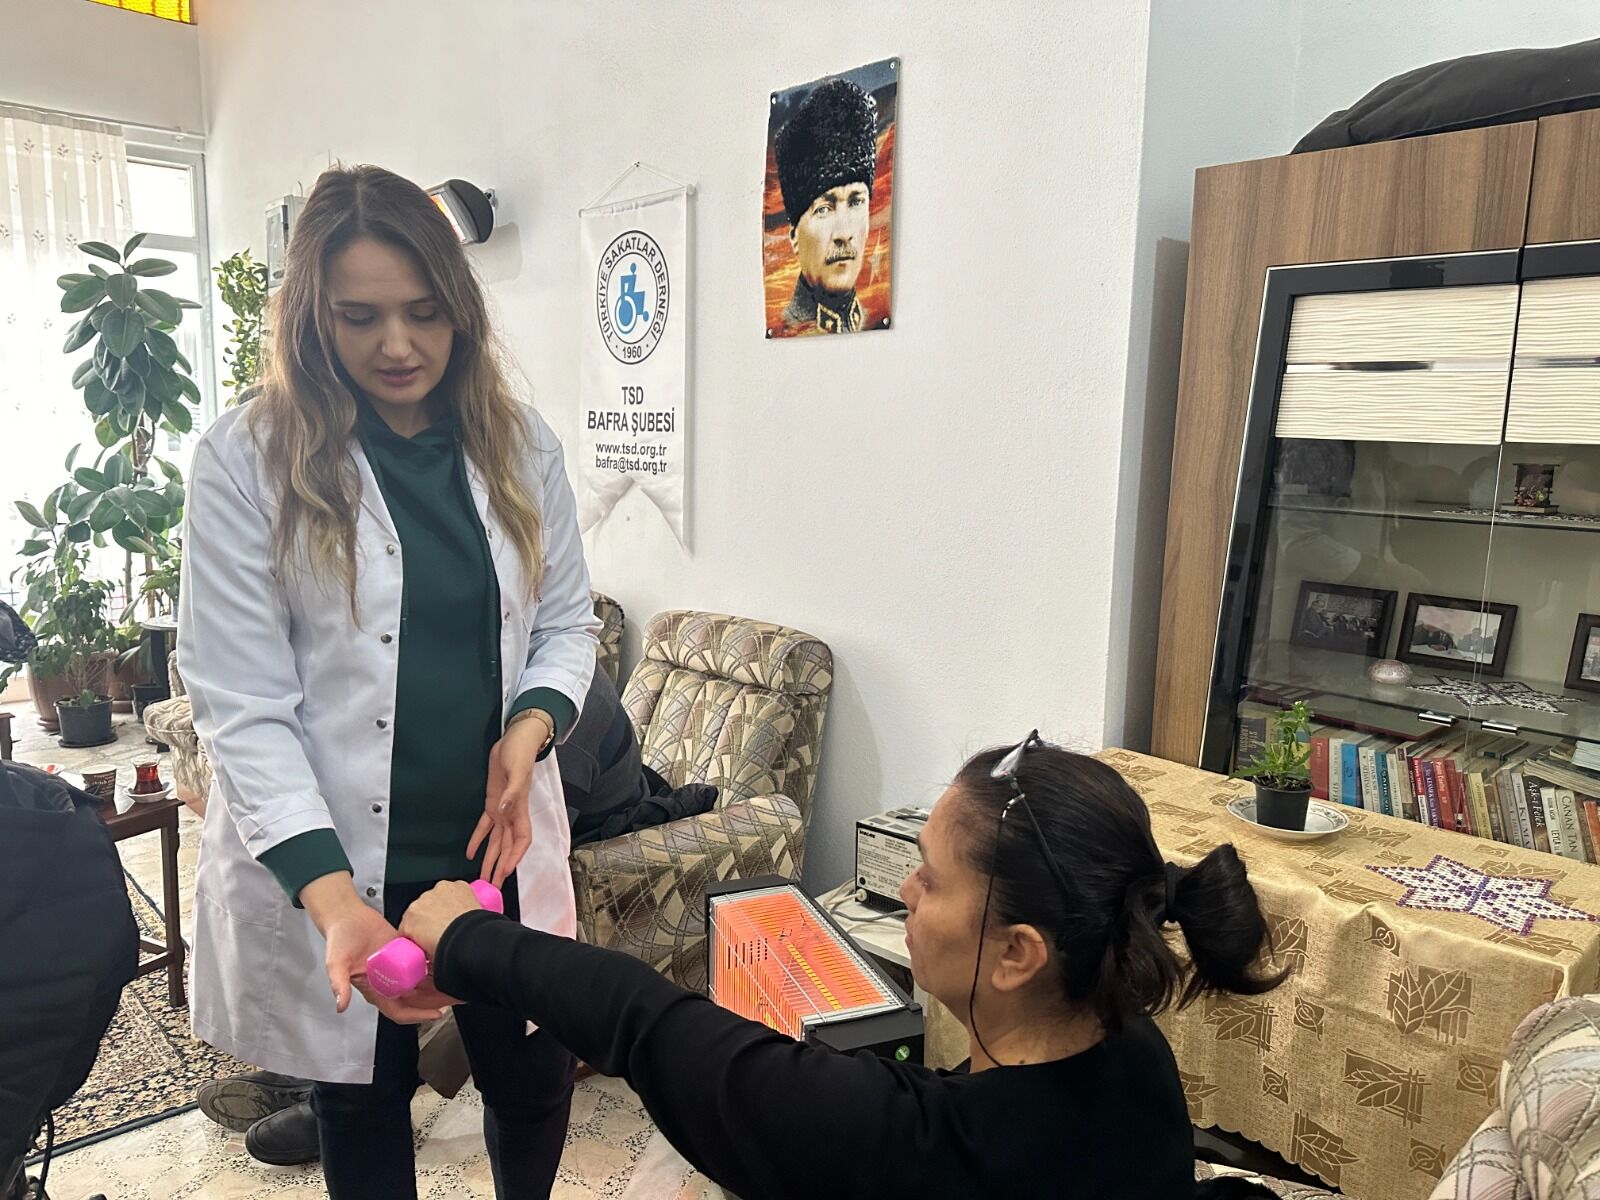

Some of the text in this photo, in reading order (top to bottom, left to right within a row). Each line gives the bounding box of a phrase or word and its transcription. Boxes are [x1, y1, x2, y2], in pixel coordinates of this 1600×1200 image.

[604, 237, 656, 269] SAKATLAR
[599, 269, 613, 343] TÜRKİYE
[622, 346, 642, 358] 1960
[621, 386, 644, 405] TSD
[587, 407, 675, 437] BAFRA ŞUBESİ
[595, 442, 667, 459] www.tsd.org.tr
[595, 455, 667, 475] bafra@tsd.org.tr
[1533, 805, 1545, 828] Felek
[1561, 795, 1578, 853] CANAN TAN
